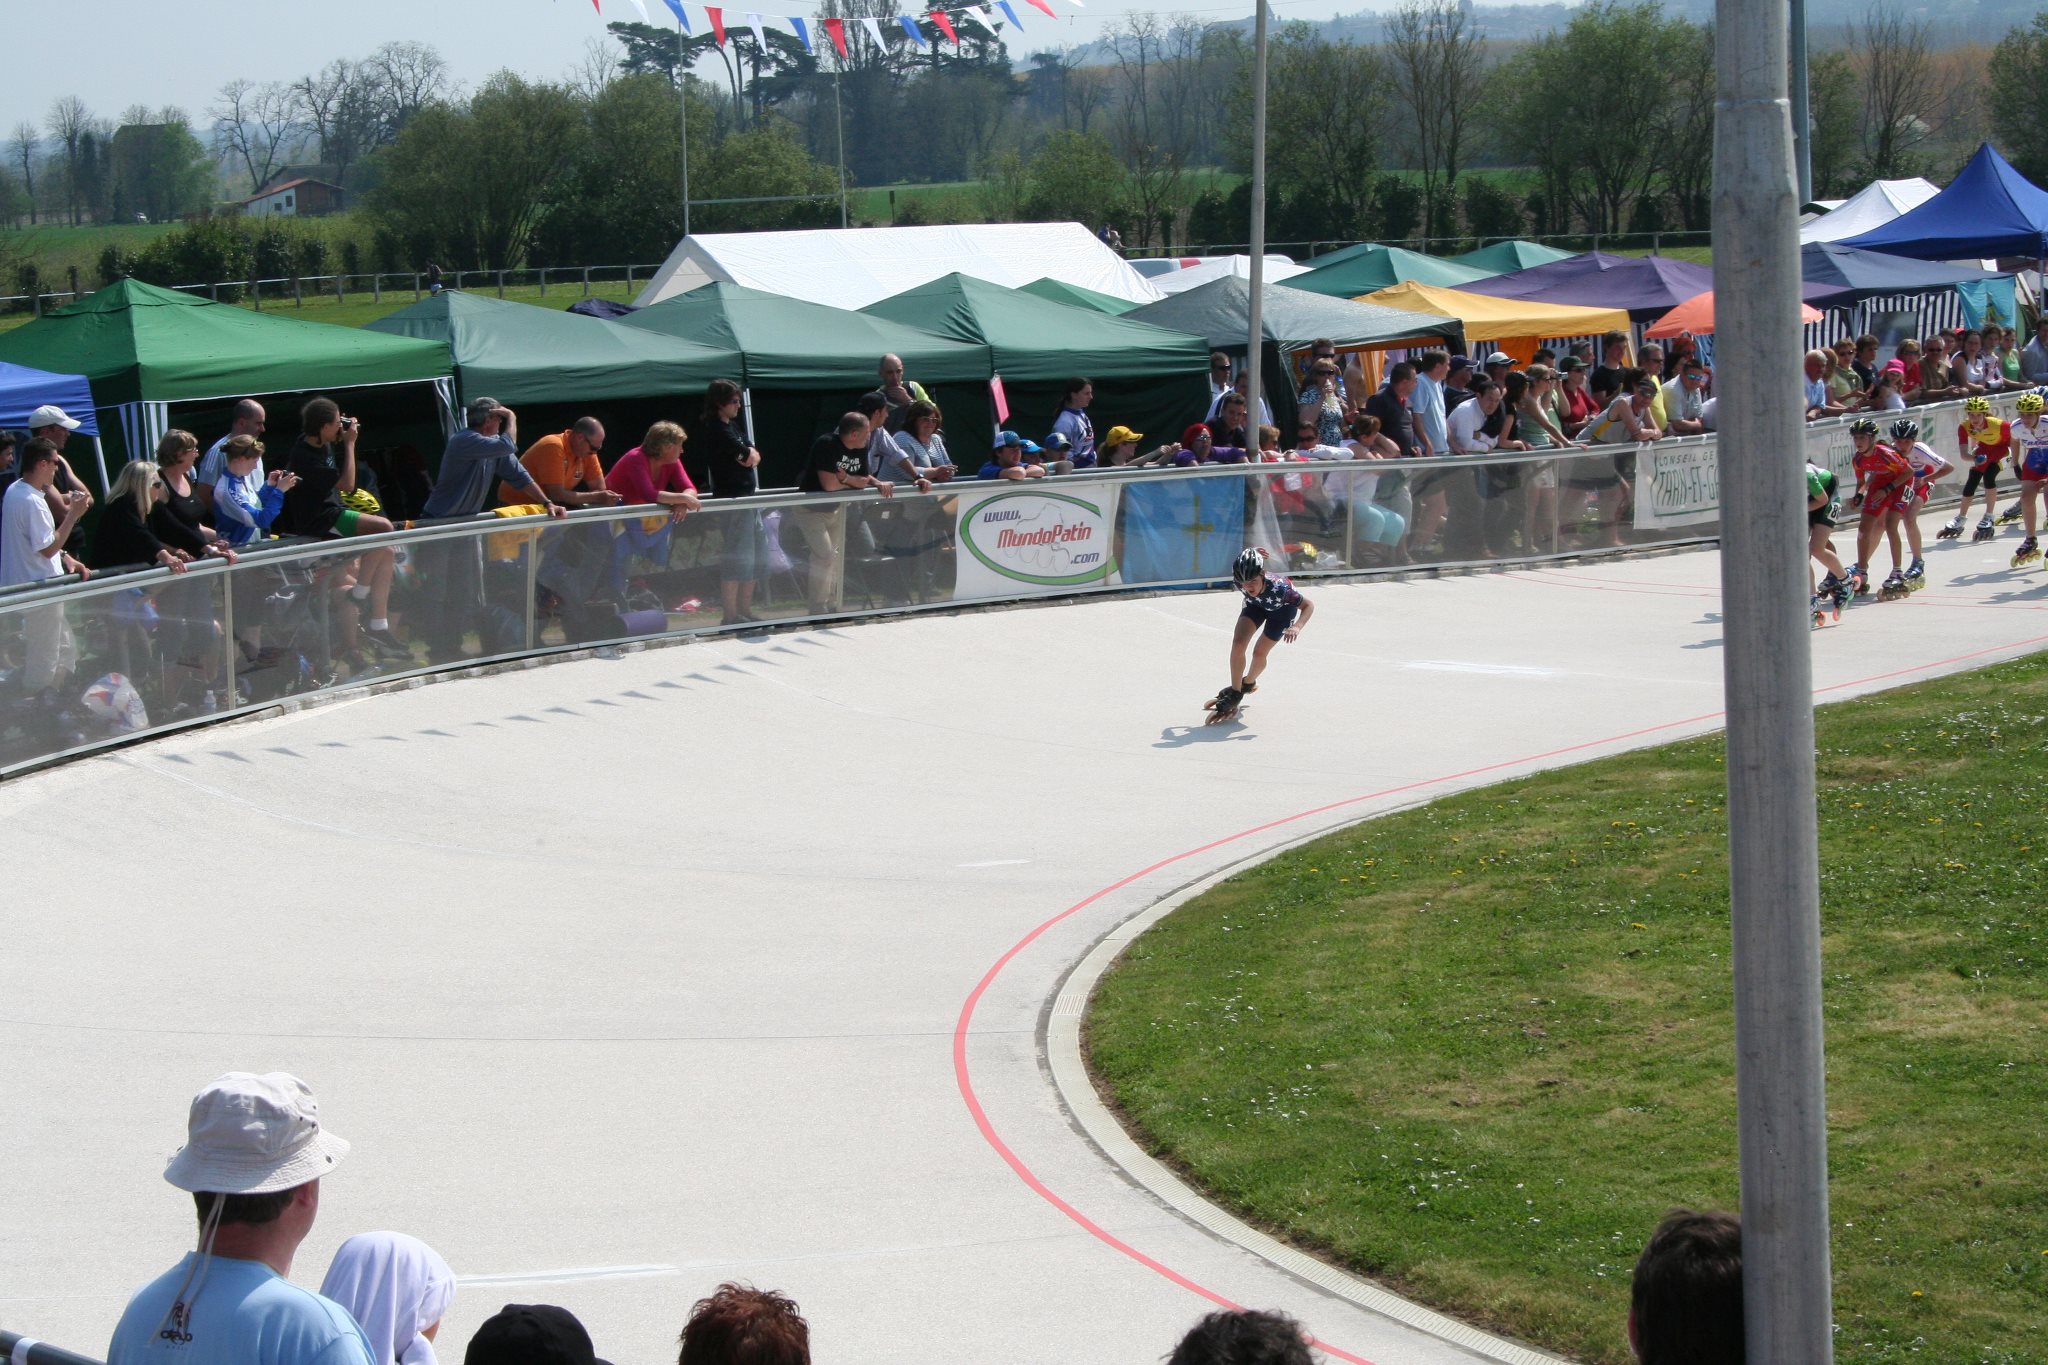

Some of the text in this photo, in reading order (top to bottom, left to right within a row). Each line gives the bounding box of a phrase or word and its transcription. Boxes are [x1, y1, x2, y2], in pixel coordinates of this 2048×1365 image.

[983, 509, 1022, 523] www.
[996, 521, 1092, 549] MundoPatin
[1070, 552, 1100, 565] .com
